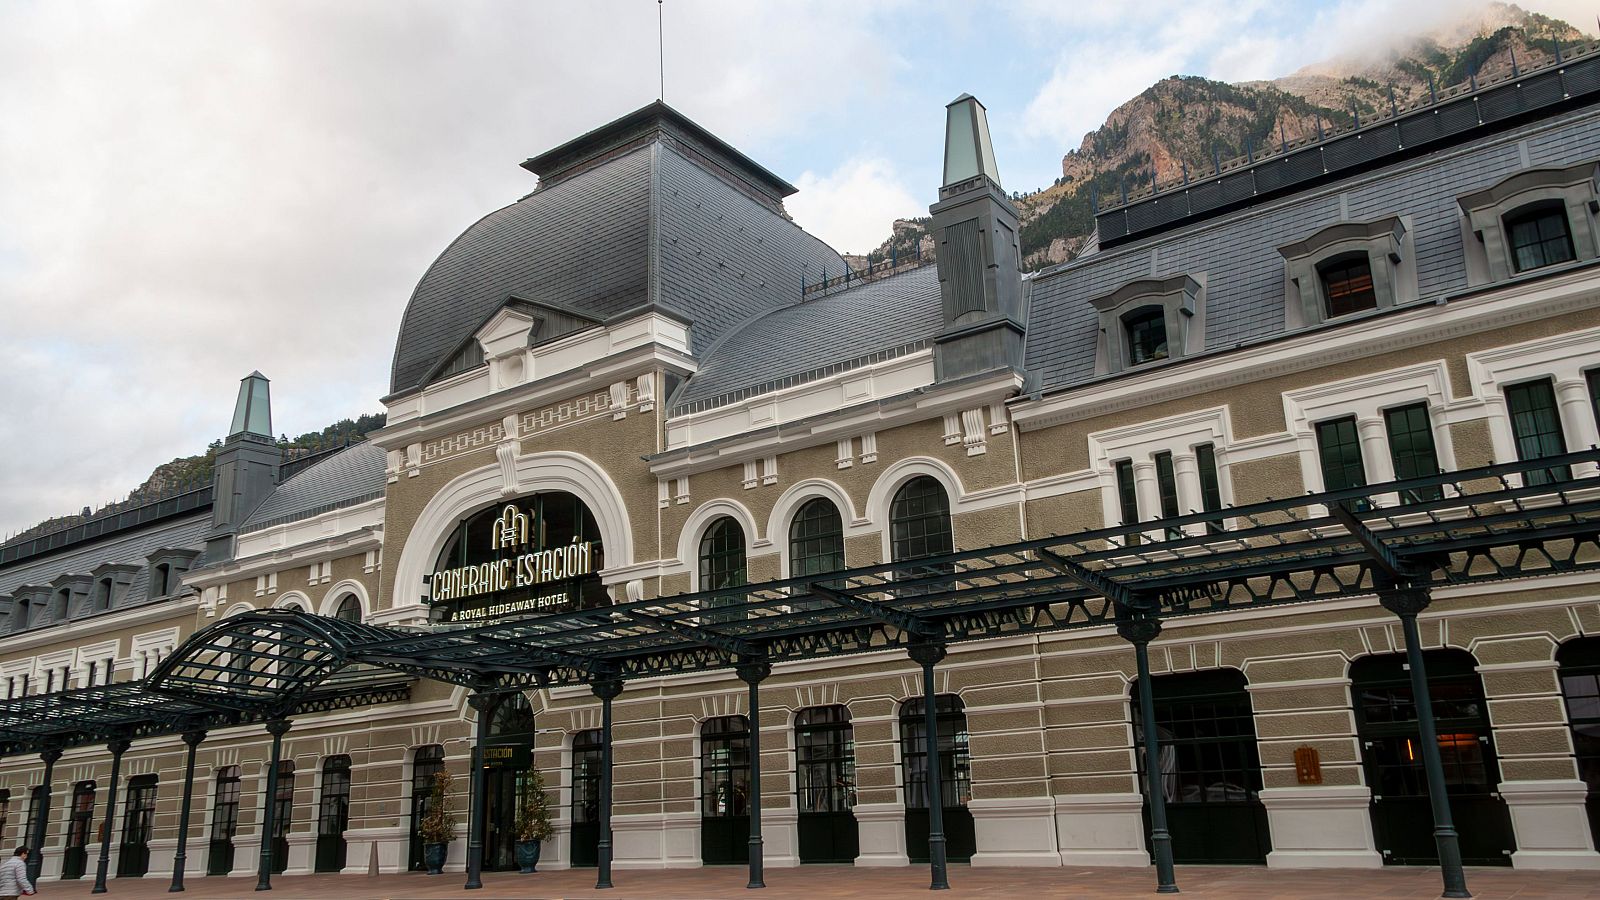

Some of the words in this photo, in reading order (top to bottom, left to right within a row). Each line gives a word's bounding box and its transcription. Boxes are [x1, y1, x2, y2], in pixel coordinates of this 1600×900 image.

[432, 558, 509, 602] CANFRANC
[515, 536, 591, 587] ESTACIÓN
[451, 612, 458, 623] A
[459, 607, 487, 620] ROYAL
[489, 598, 536, 615] HIDEAWAY
[538, 592, 568, 607] HOTEL
